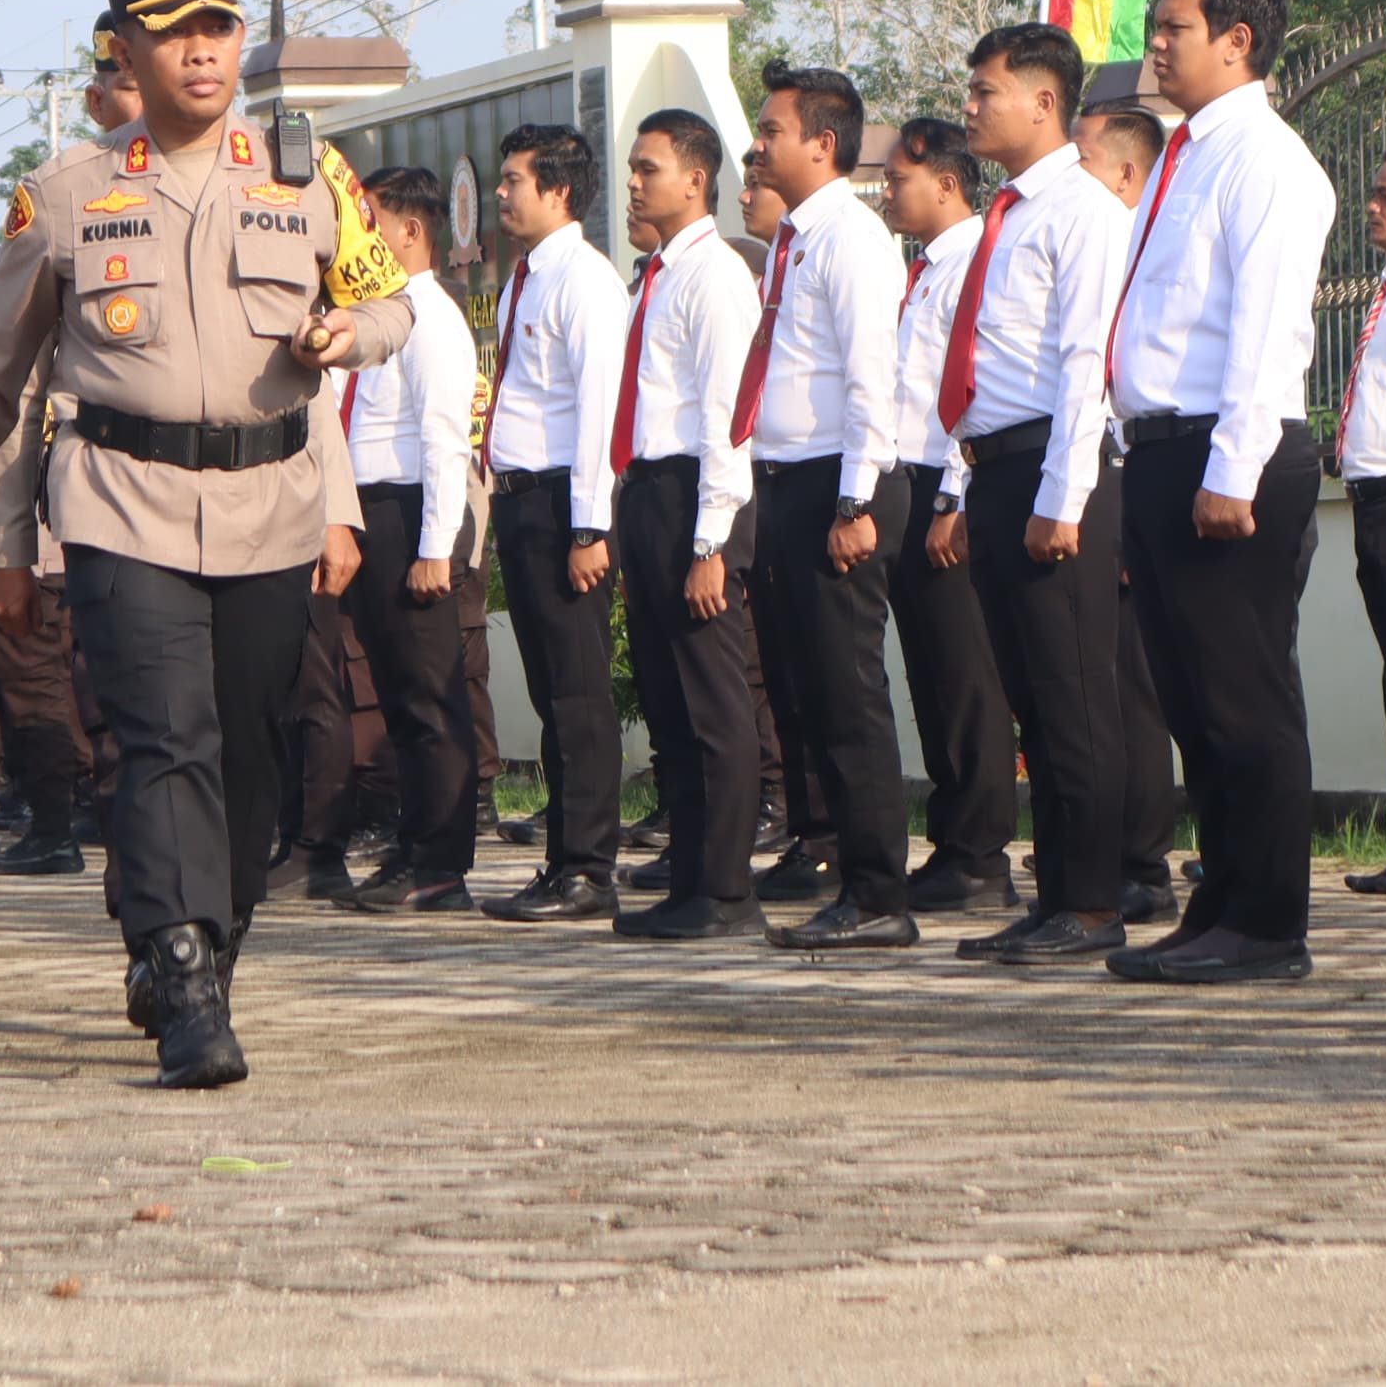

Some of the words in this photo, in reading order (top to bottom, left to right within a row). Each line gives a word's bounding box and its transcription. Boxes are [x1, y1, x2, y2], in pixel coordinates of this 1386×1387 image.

[82, 219, 153, 245] KURNIA
[240, 211, 308, 236] POLRI
[339, 256, 373, 286] KA
[352, 277, 381, 301] OMB
